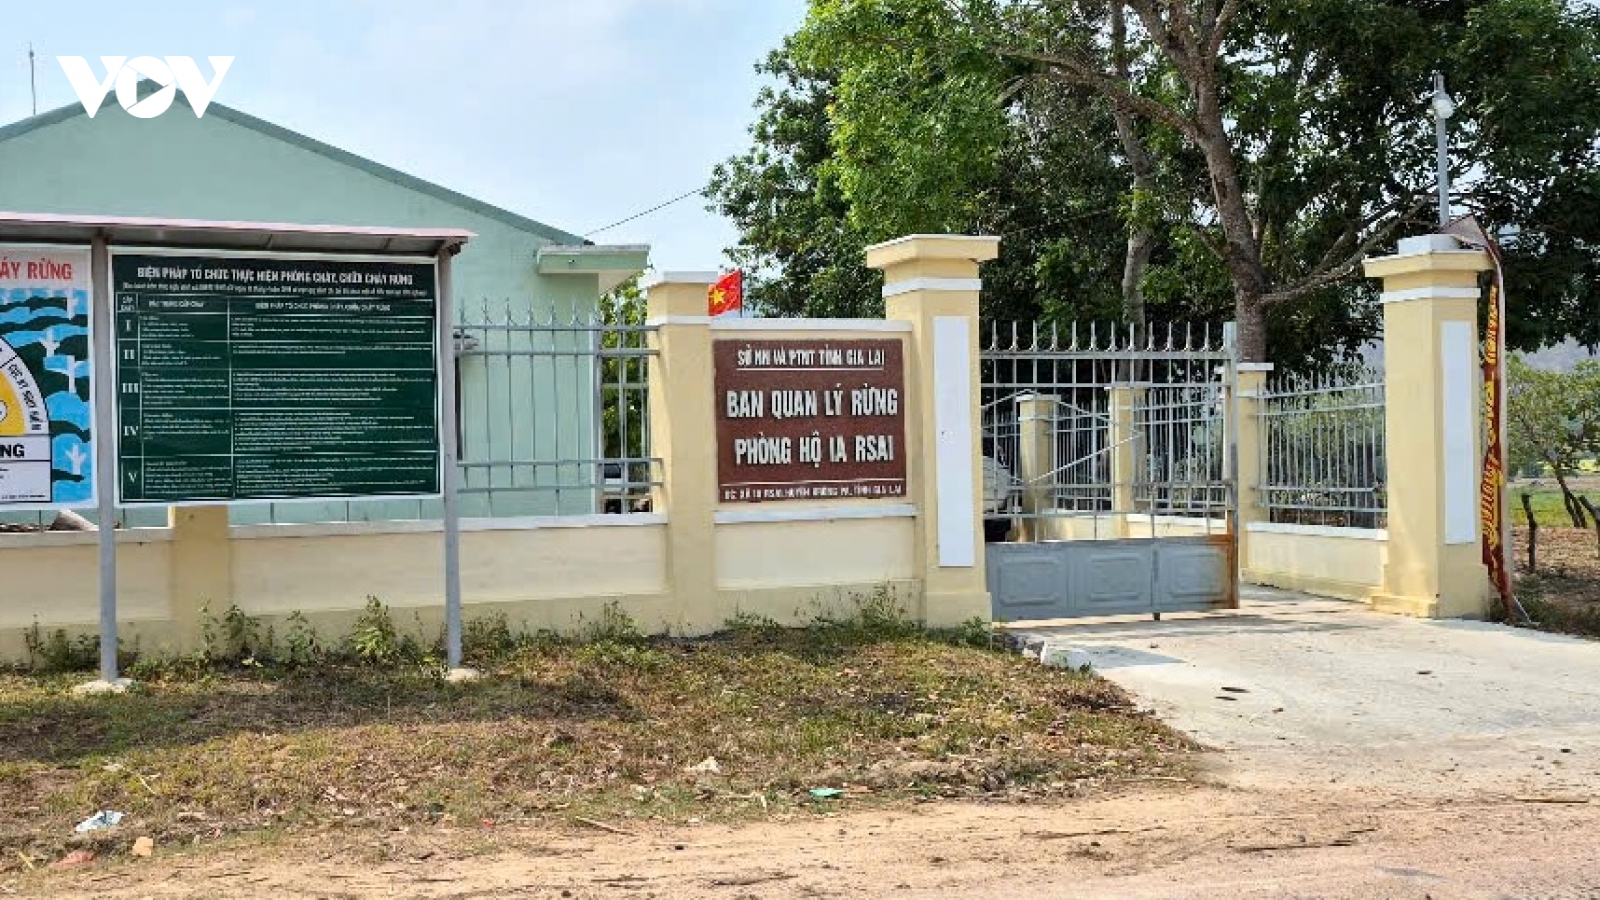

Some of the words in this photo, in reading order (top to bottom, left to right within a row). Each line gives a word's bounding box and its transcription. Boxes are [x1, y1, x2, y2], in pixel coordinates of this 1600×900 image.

[28, 258, 72, 279] RỪNG
[125, 319, 131, 331] I
[124, 349, 135, 360] II
[846, 350, 864, 366] GIA
[868, 350, 885, 366] LAI
[122, 382, 139, 394] III
[727, 390, 764, 418] BAN
[825, 383, 844, 417] LÝ
[851, 383, 898, 417] RỪNG
[124, 425, 139, 437] IV
[735, 431, 792, 465] PHÒNG
[799, 430, 822, 468] HỘ
[829, 435, 848, 463] IA
[855, 435, 894, 463] RSAI
[127, 472, 138, 484] V
